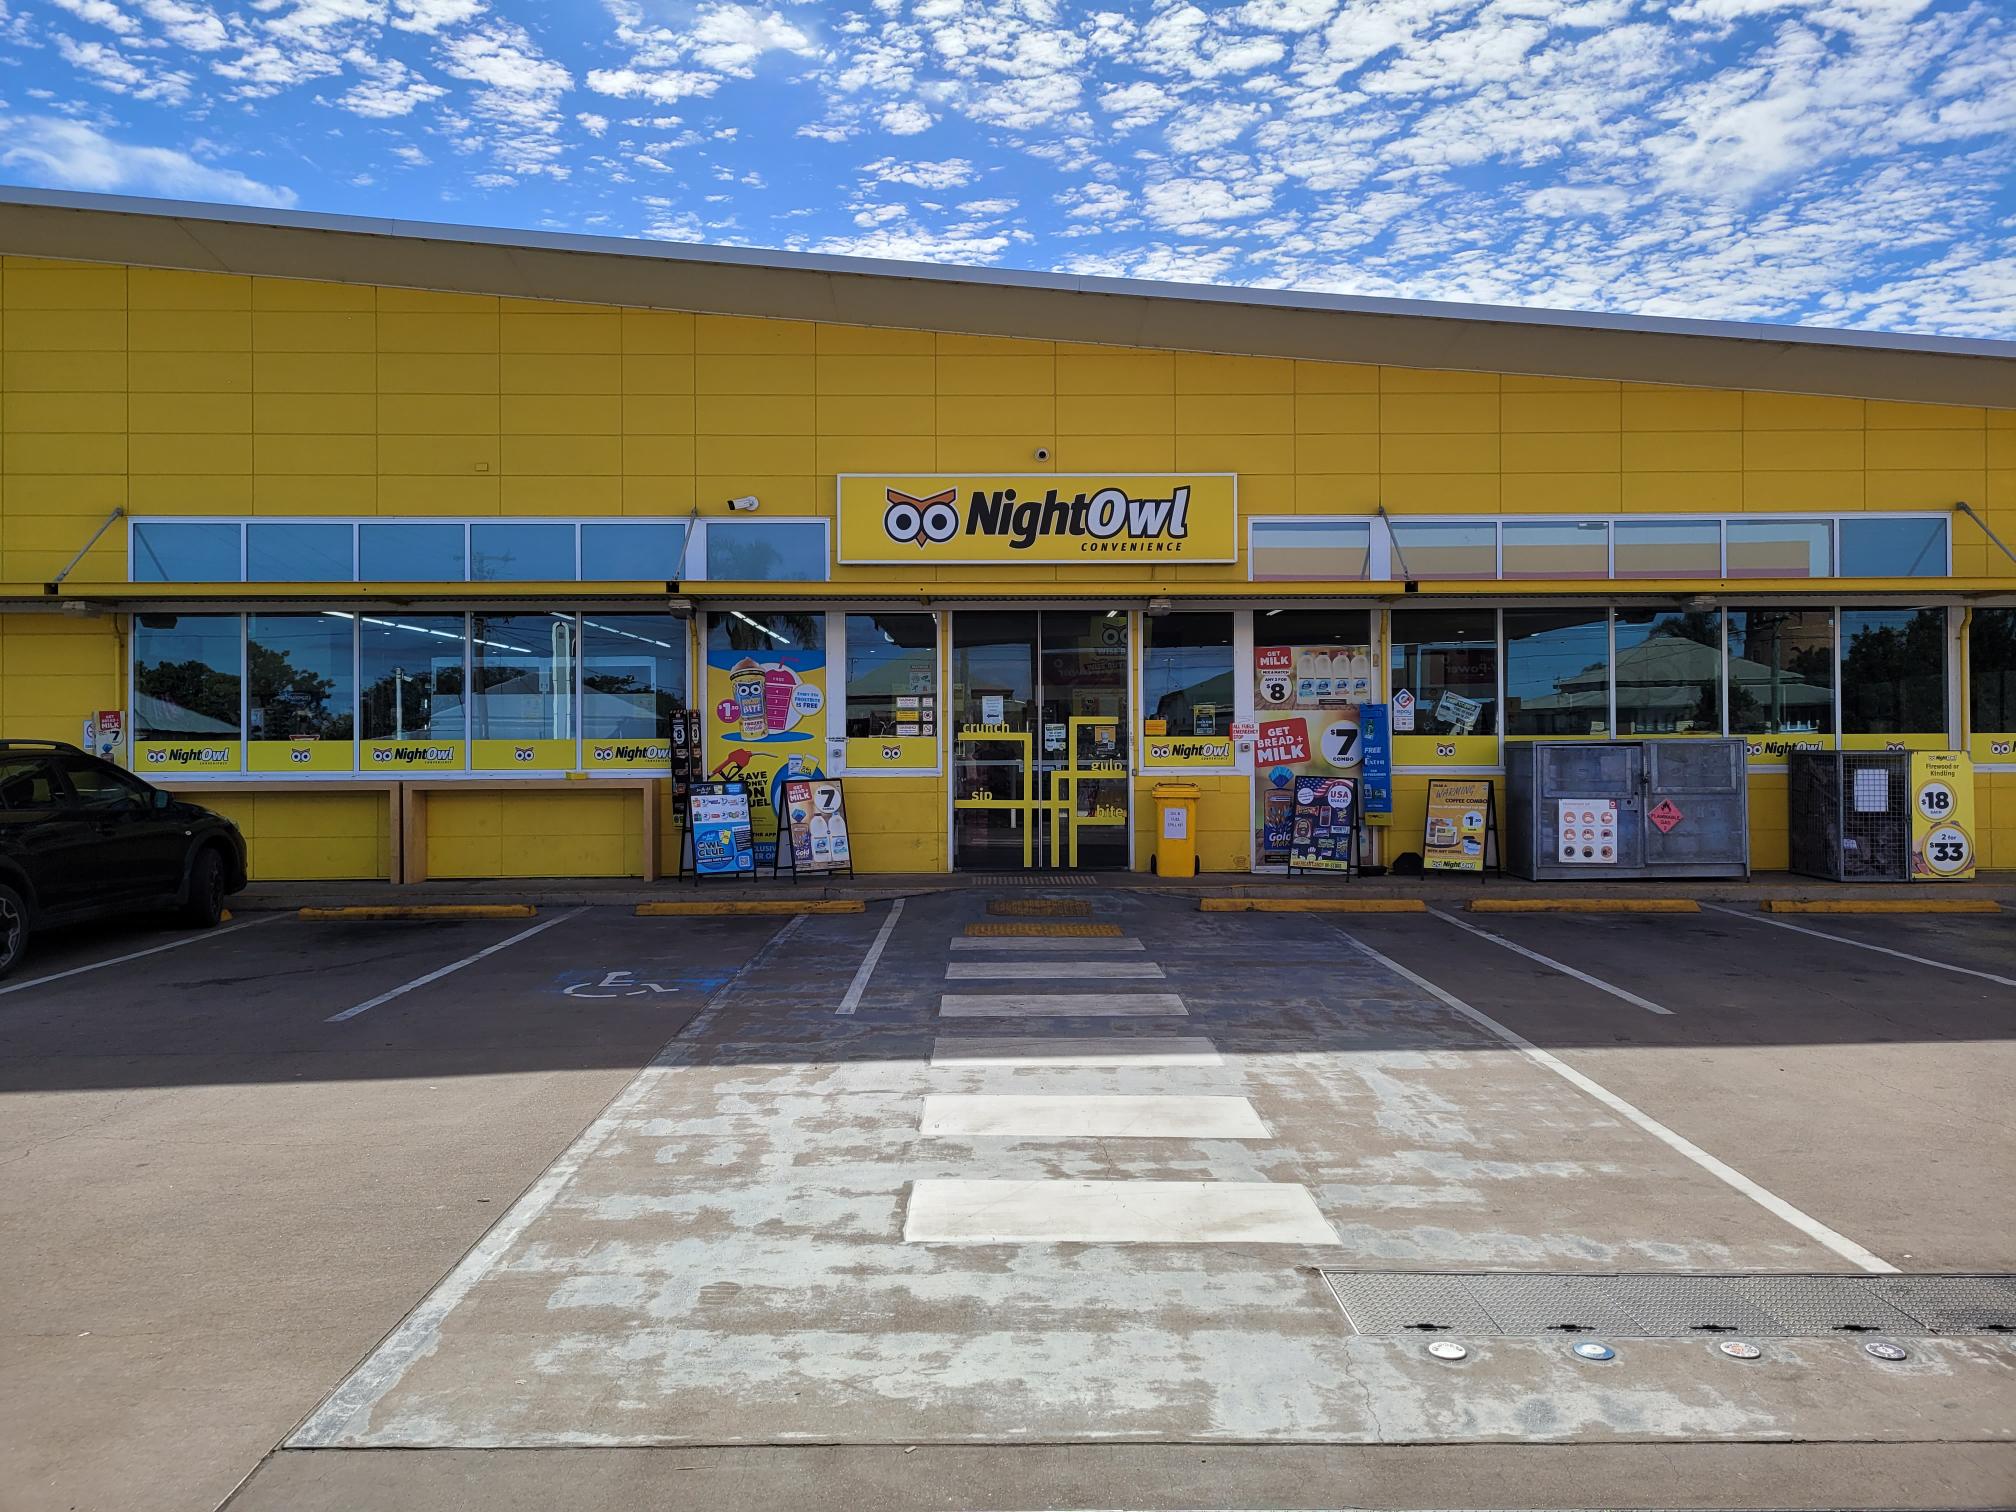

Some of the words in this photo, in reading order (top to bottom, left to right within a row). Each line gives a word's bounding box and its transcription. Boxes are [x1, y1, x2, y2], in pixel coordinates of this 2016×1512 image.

[965, 485, 1191, 549] NightOwl
[1081, 542, 1183, 552] CONVENIENCE
[1260, 656, 1289, 666] MILK
[1266, 683, 1285, 701] $8
[962, 721, 1010, 733] crunch
[1267, 726, 1290, 736] GET
[1257, 735, 1294, 748] BREAD
[1330, 728, 1358, 756] $7
[395, 746, 454, 762] NightOwl
[1172, 743, 1230, 759] NightOwl
[1257, 744, 1305, 763] MILK
[1764, 741, 1824, 756] NightOwl
[169, 748, 229, 764] NightOwl
[738, 771, 767, 781] SAVE
[789, 793, 811, 801] MILK
[971, 787, 993, 801] sip
[1330, 791, 1349, 799] USA
[1436, 785, 1474, 798] WARMING
[749, 798, 770, 807] UEL
[1921, 791, 1949, 809] $18
[1096, 804, 1124, 817] bite
[1651, 813, 1681, 821] FLAMMABLE
[698, 841, 722, 849] OWL
[1929, 842, 1964, 861] $33
[699, 848, 725, 857] CLUB
[1443, 860, 1475, 869] NightOwl
